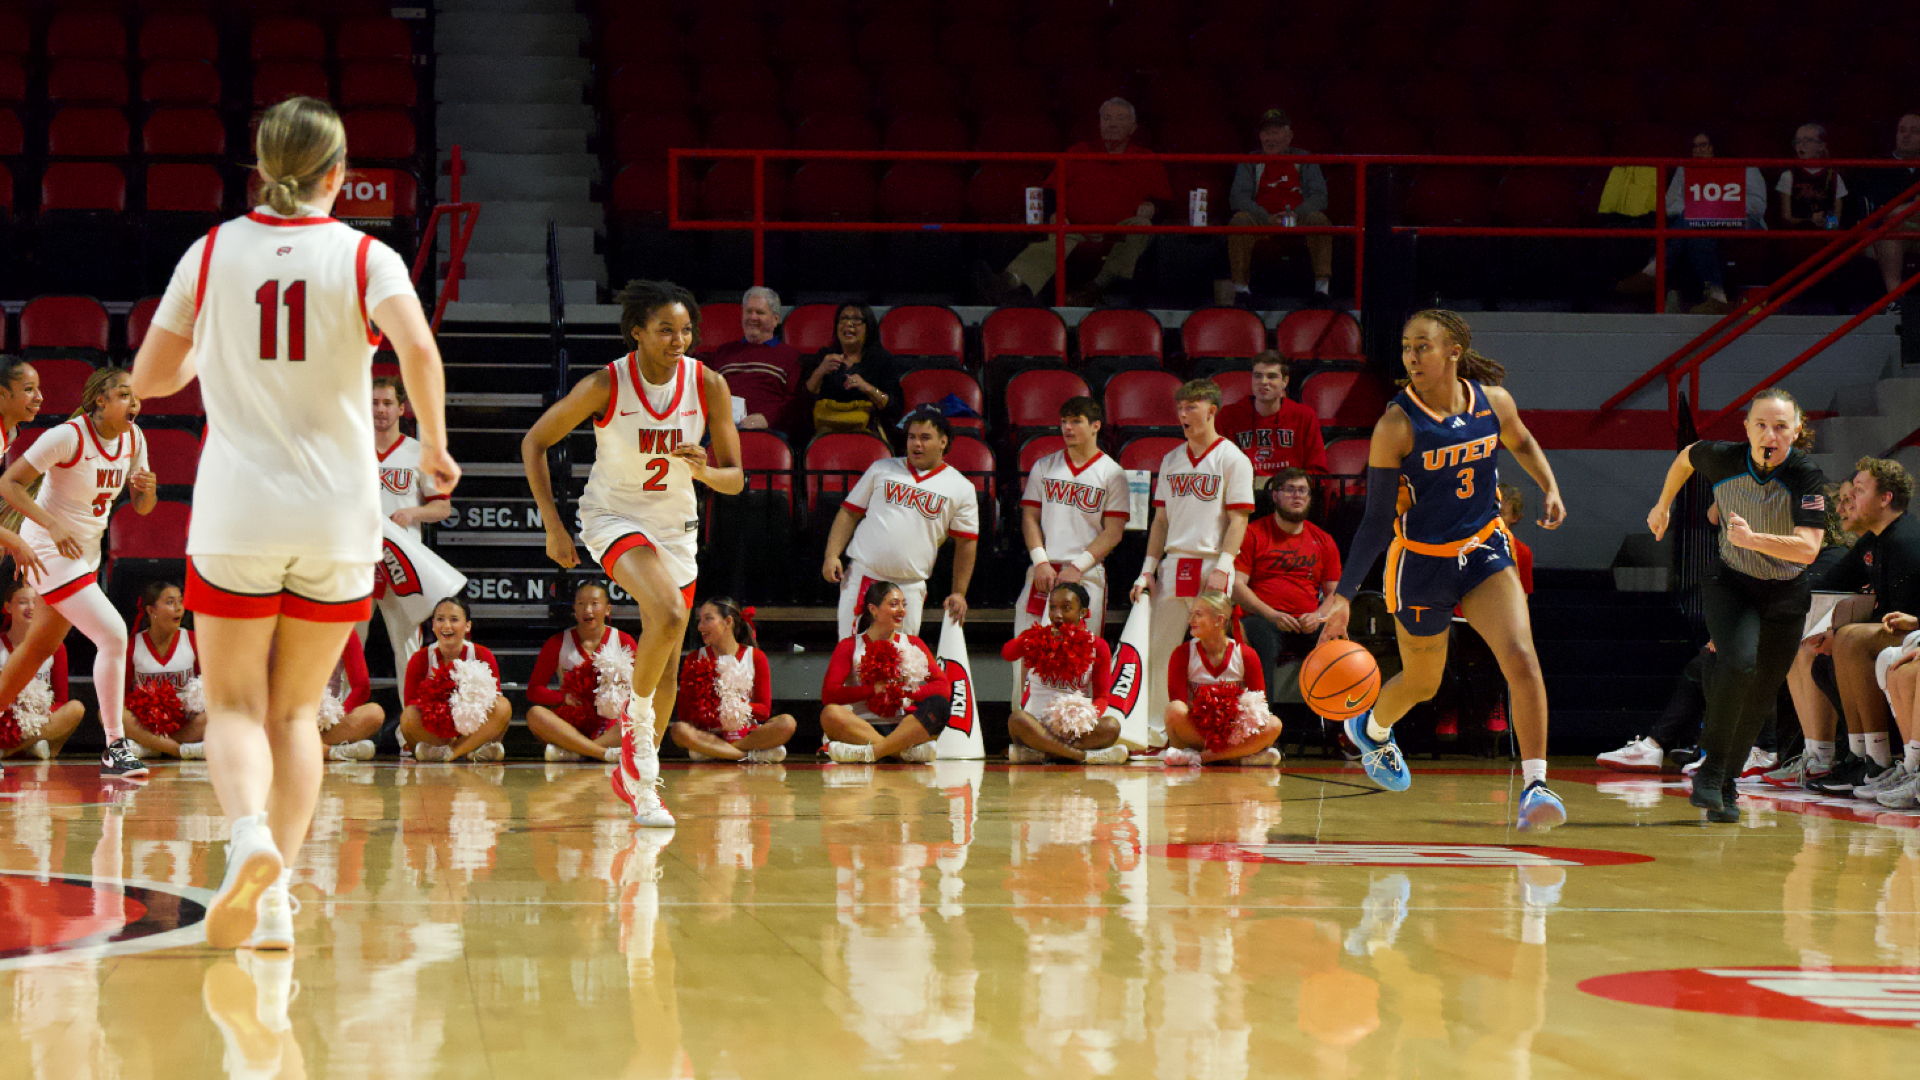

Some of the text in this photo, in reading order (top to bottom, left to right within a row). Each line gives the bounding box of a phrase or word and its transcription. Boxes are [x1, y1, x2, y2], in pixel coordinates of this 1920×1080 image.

[341, 181, 387, 201] 101
[1689, 182, 1741, 202] 102
[255, 279, 307, 362] 11
[638, 428, 683, 454] WKU
[1235, 428, 1294, 450] WKU
[1422, 433, 1498, 471] UTEP
[96, 468, 123, 489] WKU
[379, 467, 413, 495] KU
[642, 458, 670, 491] 2
[1166, 473, 1222, 502] WKU
[1456, 467, 1475, 499] 3
[92, 492, 113, 517] 5
[884, 480, 949, 520] WKU
[1042, 478, 1106, 513] WKU
[467, 507, 518, 528] SEC.
[466, 579, 544, 599] SEC. N
[1112, 663, 1136, 699] WKU
[950, 679, 967, 719] WKU
